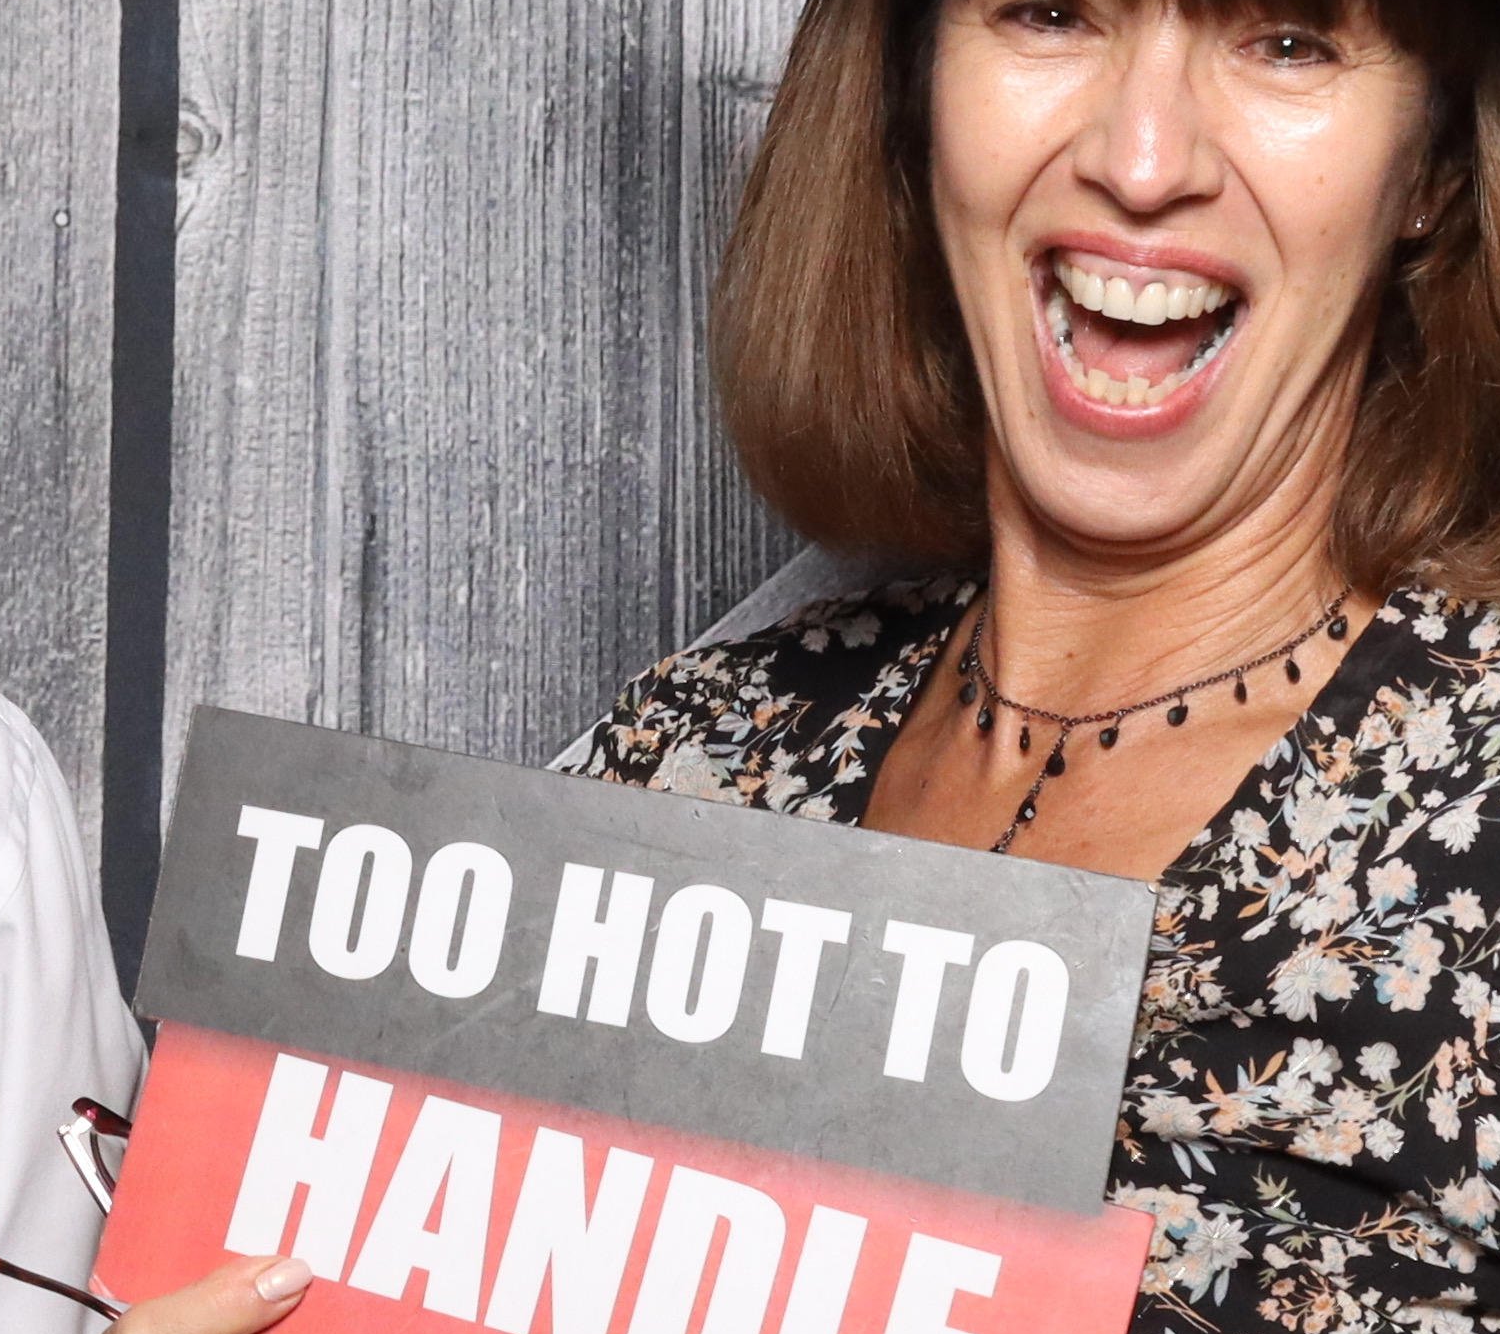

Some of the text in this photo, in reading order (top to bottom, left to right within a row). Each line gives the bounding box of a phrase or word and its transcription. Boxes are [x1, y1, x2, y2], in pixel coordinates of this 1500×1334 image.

[235, 804, 1071, 1103] TOO HOT TO
